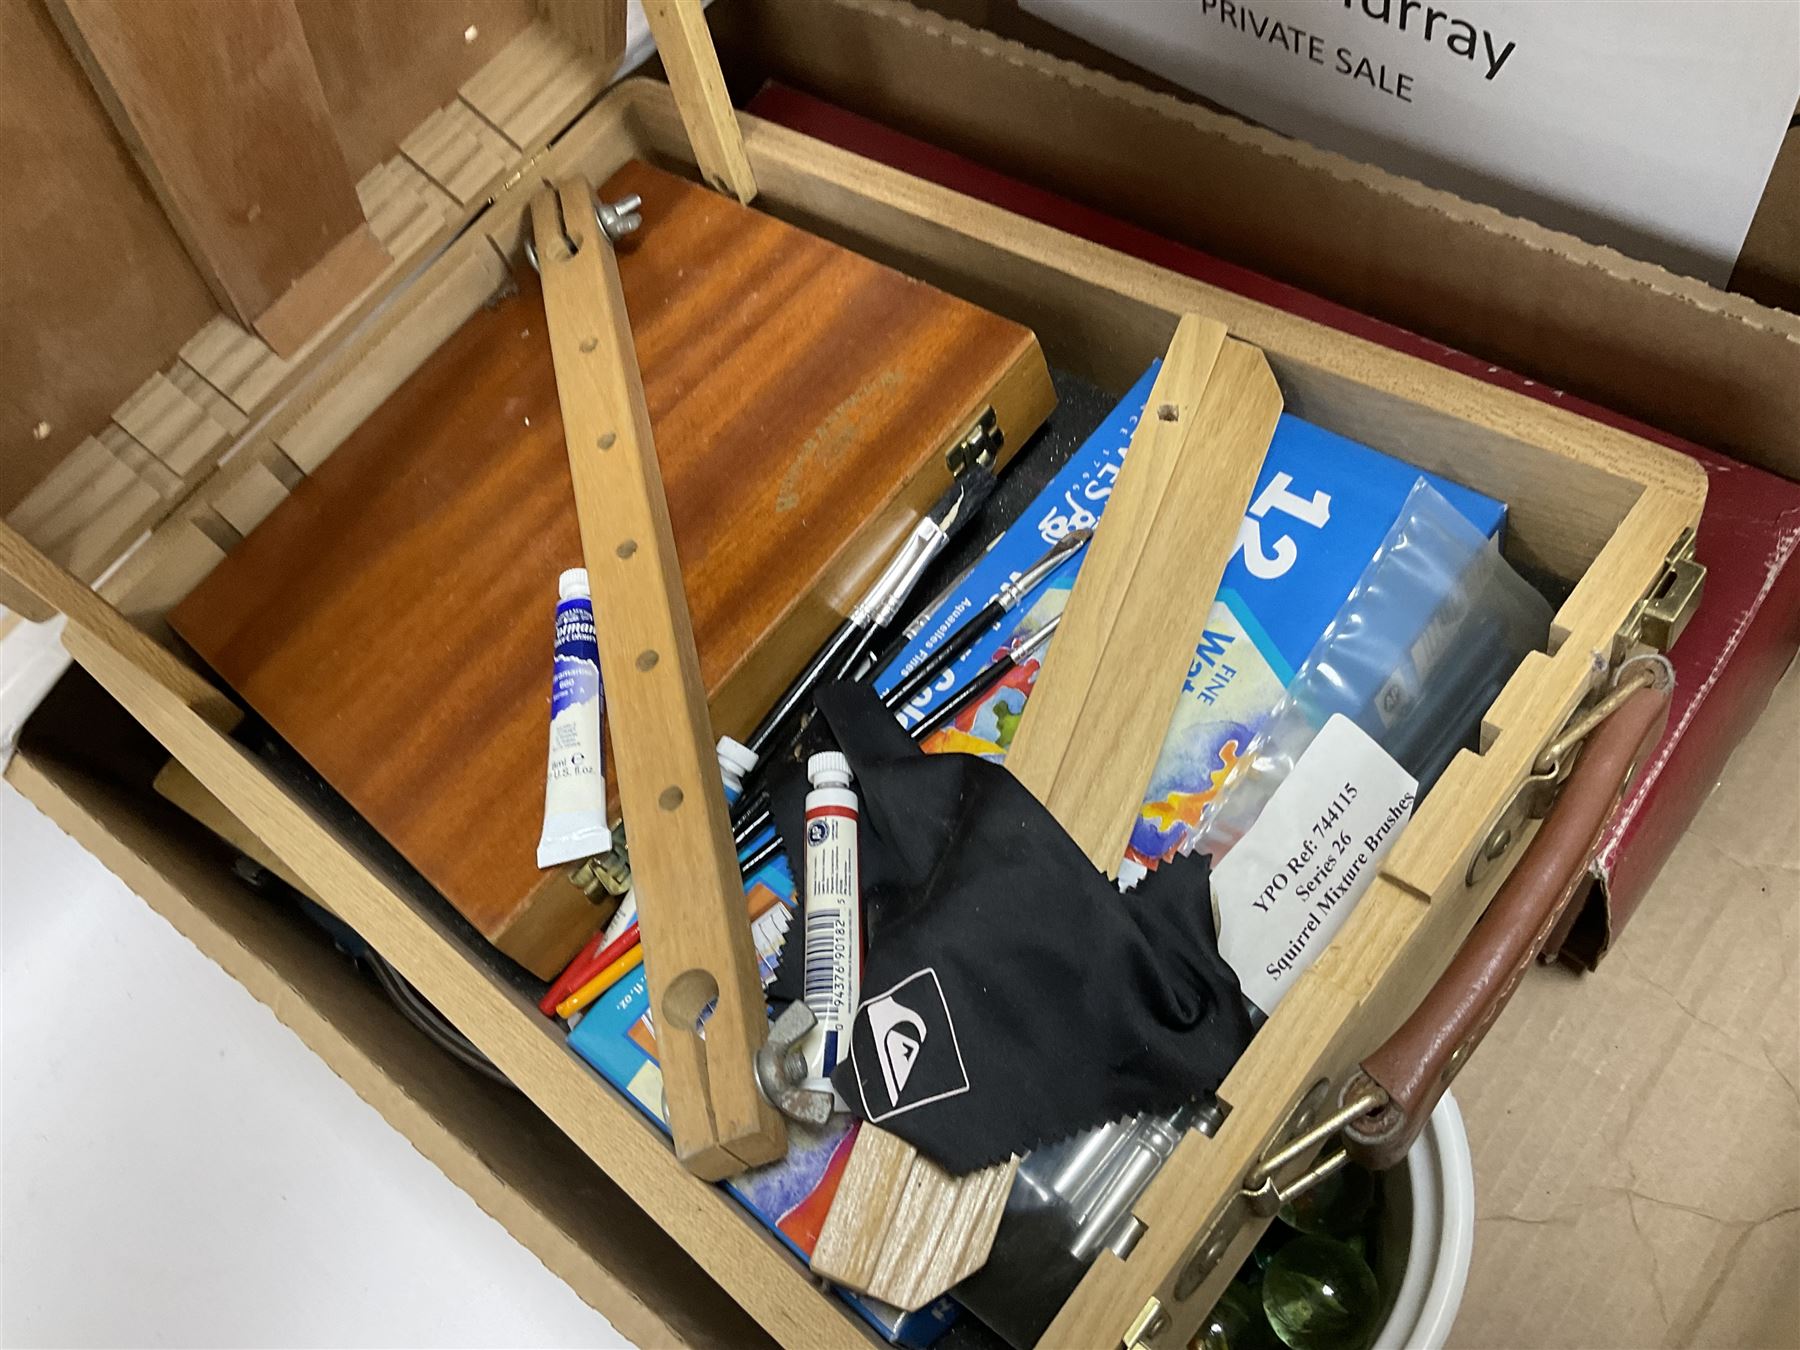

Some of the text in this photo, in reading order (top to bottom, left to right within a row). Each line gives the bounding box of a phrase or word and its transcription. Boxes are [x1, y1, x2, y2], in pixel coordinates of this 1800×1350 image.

[1202, 0, 1414, 103] PRIVATE SALE
[1344, 0, 1516, 80] urray
[1226, 471, 1331, 579] 12
[901, 597, 972, 677] Aquarelles Fines
[1197, 664, 1237, 706] FINE
[1252, 782, 1358, 914] YPO Ref: 744115
[1266, 792, 1415, 981] Squirrel Mixture Brushes
[1295, 829, 1352, 902] Series 26
[835, 920, 846, 958] 90182
[834, 966, 845, 1007] 94376
